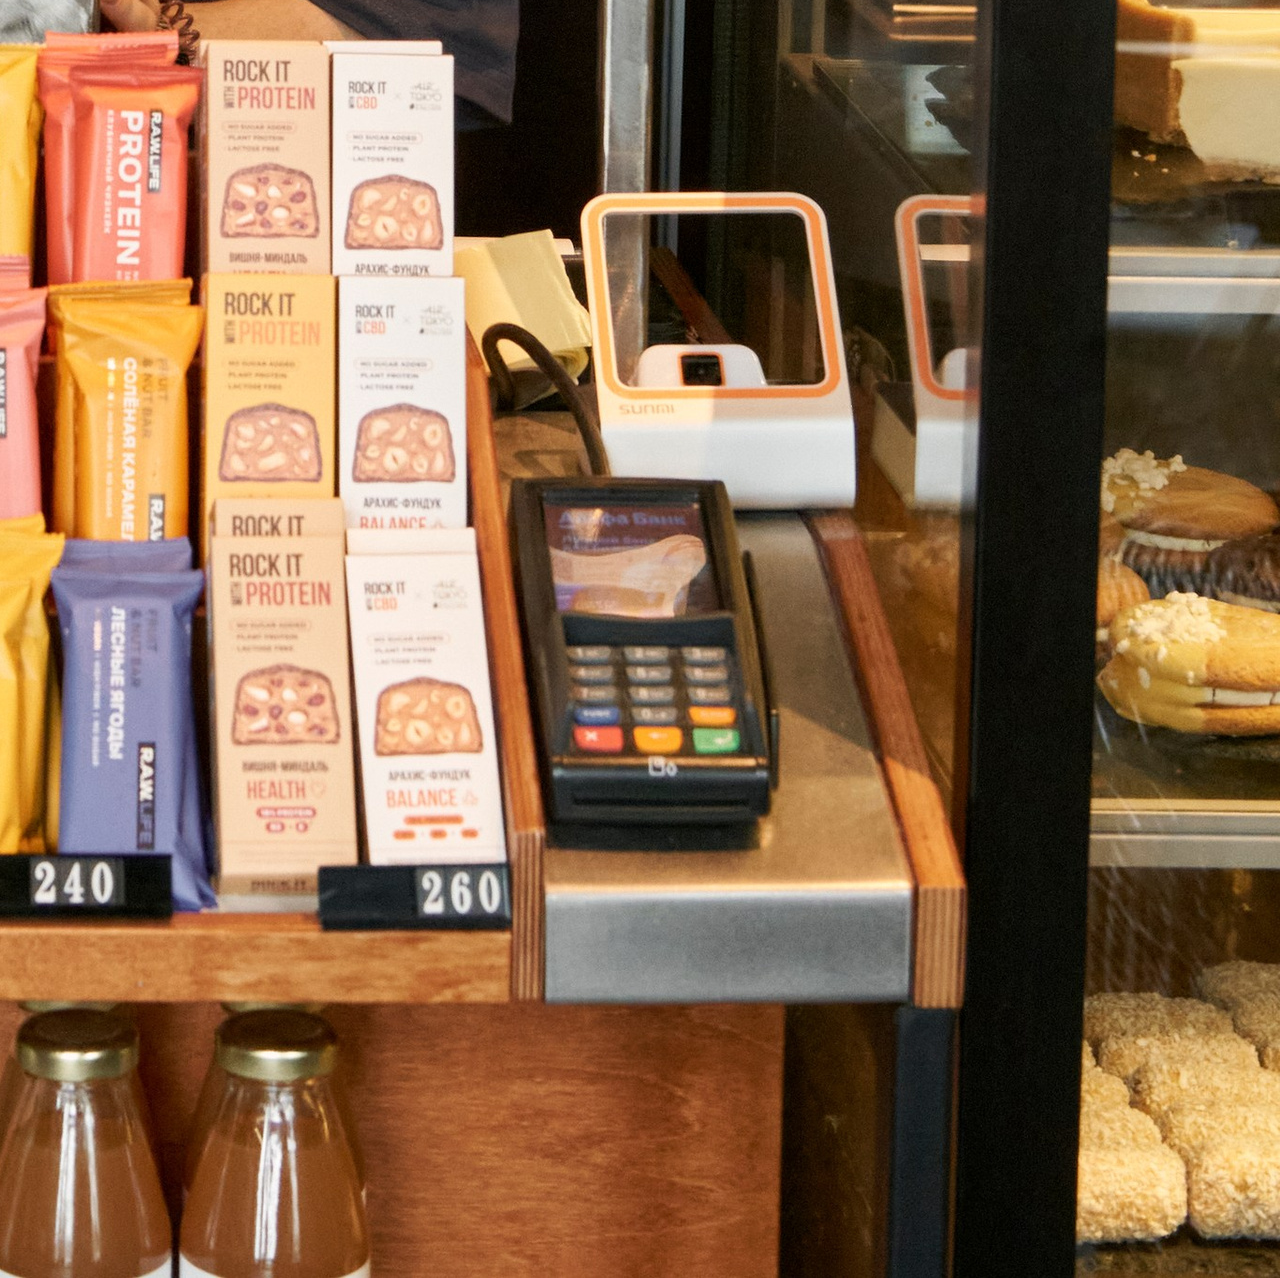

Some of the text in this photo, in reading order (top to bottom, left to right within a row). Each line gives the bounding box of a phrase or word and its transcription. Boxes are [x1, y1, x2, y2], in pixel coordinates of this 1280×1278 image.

[223, 60, 291, 82] ROCK IT
[348, 81, 387, 94] ROCK IT
[238, 87, 315, 110] PROTEIN
[356, 96, 377, 109] CBD
[116, 110, 144, 265] PROTEIN
[229, 252, 308, 265] ВИШНЯ-МИНДАЛЬ
[355, 263, 430, 275] АРАХИС-ФУНДУК
[224, 292, 295, 316] ROCK IT
[355, 305, 395, 318] ROCK IT
[238, 320, 320, 345] PROTEIN
[363, 323, 385, 335] CBD
[122, 357, 140, 448] СОЛЁНАЯ
[363, 497, 442, 509] АРАХИС-ФУНДУК
[230, 553, 303, 578] ROCK IT
[246, 581, 332, 606] PROTEIN
[364, 582, 405, 595] ROCK IT
[107, 606, 126, 760] ЛЕСНЫЕ ЯГОДЫ
[388, 769, 471, 782] АРАХИС-ФУНДУК
[247, 780, 306, 800] HEALTH
[386, 789, 457, 808] BALANCE
[34, 862, 114, 904] 240
[422, 871, 502, 914] 260
